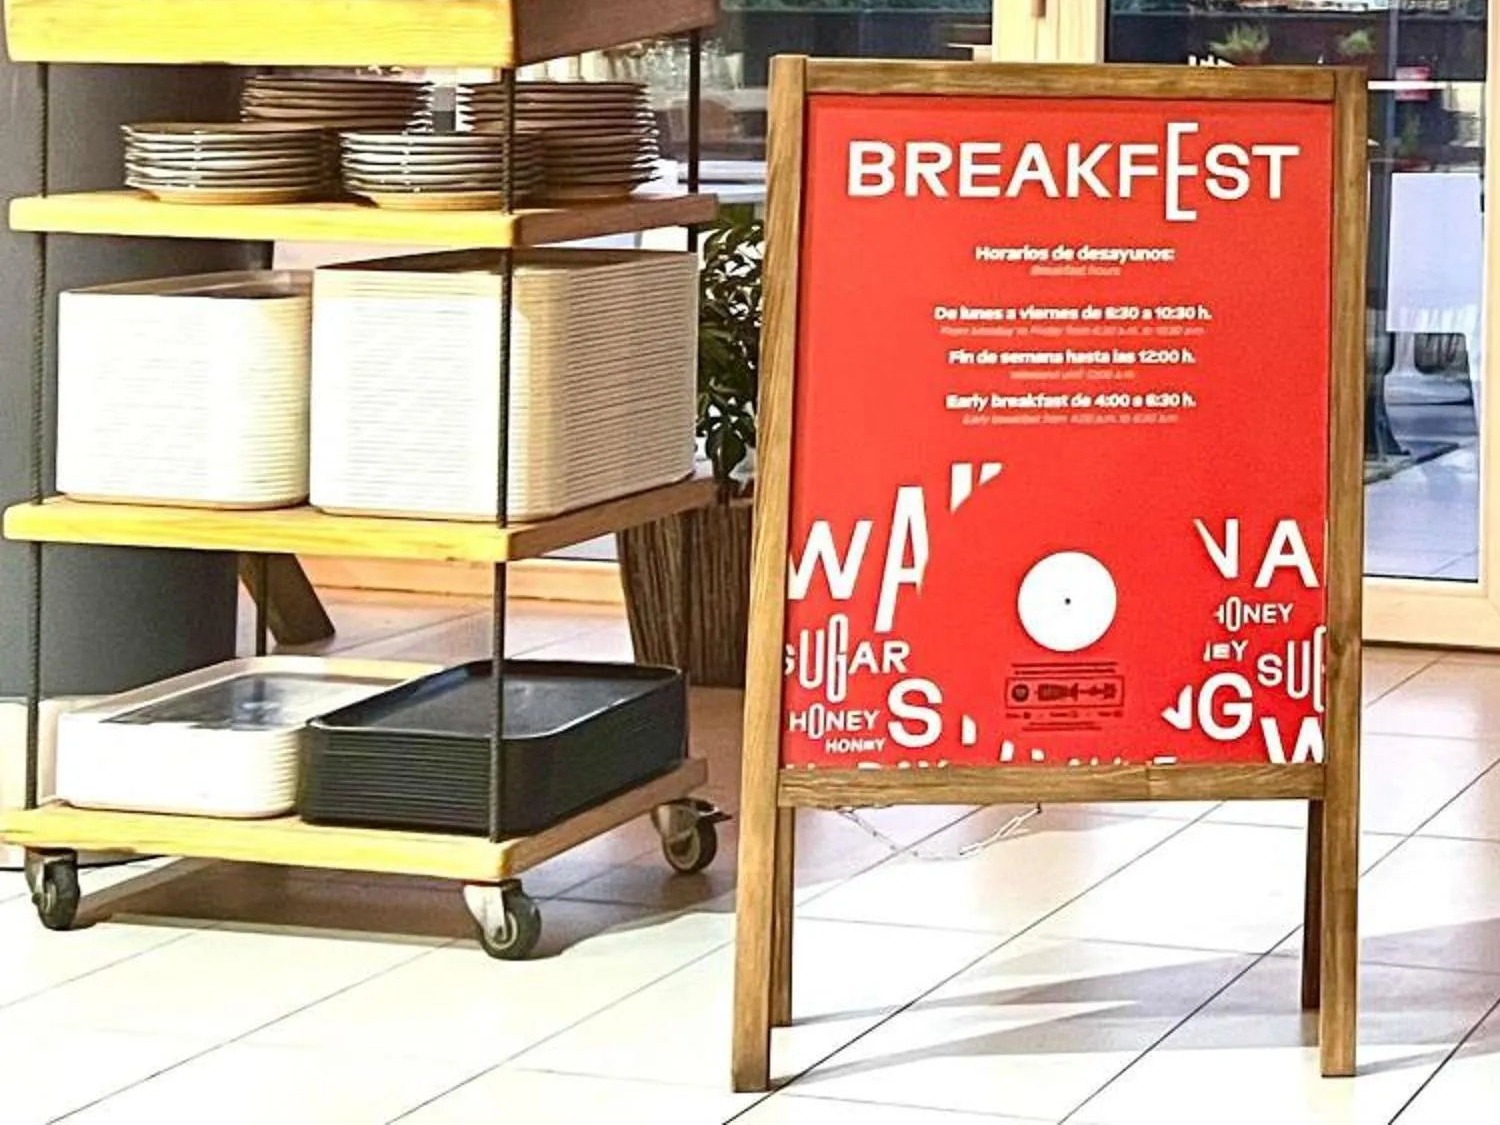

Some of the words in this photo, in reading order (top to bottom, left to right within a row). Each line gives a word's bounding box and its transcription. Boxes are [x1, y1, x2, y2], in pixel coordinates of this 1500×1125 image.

[848, 121, 1300, 222] BREAKFEST
[975, 244, 1049, 261] Horarios
[1051, 245, 1075, 261] de
[1076, 245, 1175, 265] desayunos:
[934, 305, 959, 321] De
[959, 305, 1004, 321] lunes
[1005, 308, 1017, 321] a
[1018, 305, 1079, 321] viernes
[1081, 304, 1103, 321] de
[1141, 308, 1153, 321] a
[948, 349, 975, 365] Fin
[975, 349, 999, 365] de
[999, 352, 1065, 365] semana
[1065, 349, 1111, 365] hasta
[1112, 349, 1137, 365] las
[1137, 349, 1180, 365] 12:00
[946, 393, 989, 413] Early
[990, 393, 1069, 409] breakfast
[1070, 393, 1092, 409] de
[1094, 393, 1131, 409] 4:00
[788, 703, 880, 740] HONEY
